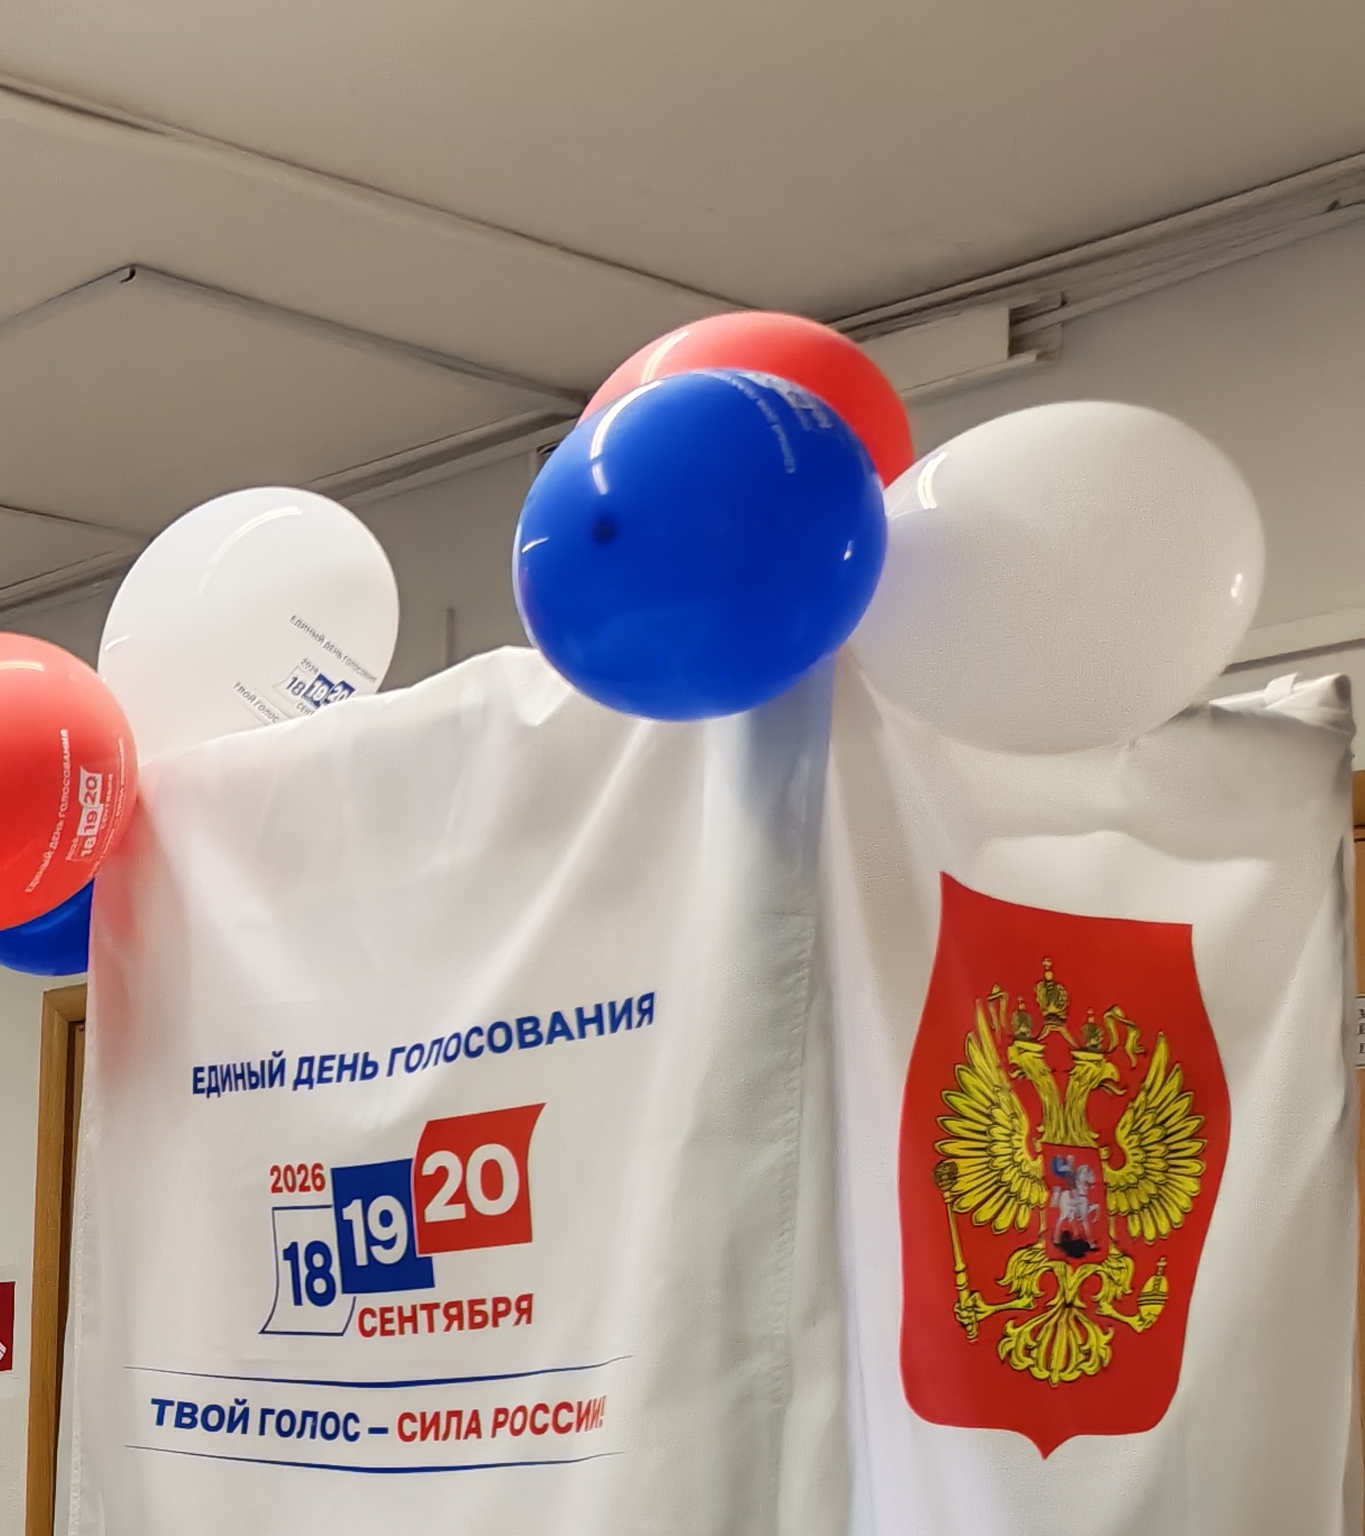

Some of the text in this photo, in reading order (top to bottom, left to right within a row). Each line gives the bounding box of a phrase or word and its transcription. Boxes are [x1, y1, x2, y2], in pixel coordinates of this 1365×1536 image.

[286, 676, 305, 696] 18
[85, 776, 98, 805] 20
[84, 811, 98, 834] 19
[192, 991, 656, 1099] ЕДИНЫЙ ДЕНЬ ГОЛОСОВАНИЯ
[269, 1162, 325, 1194] 2026
[282, 1143, 520, 1307] 18 19 20
[357, 1293, 534, 1338] СЕНТЯБРЯ
[151, 1398, 249, 1435] ТВОЙ
[258, 1407, 361, 1442] ГОЛОС
[396, 1410, 482, 1443] СИЛА
